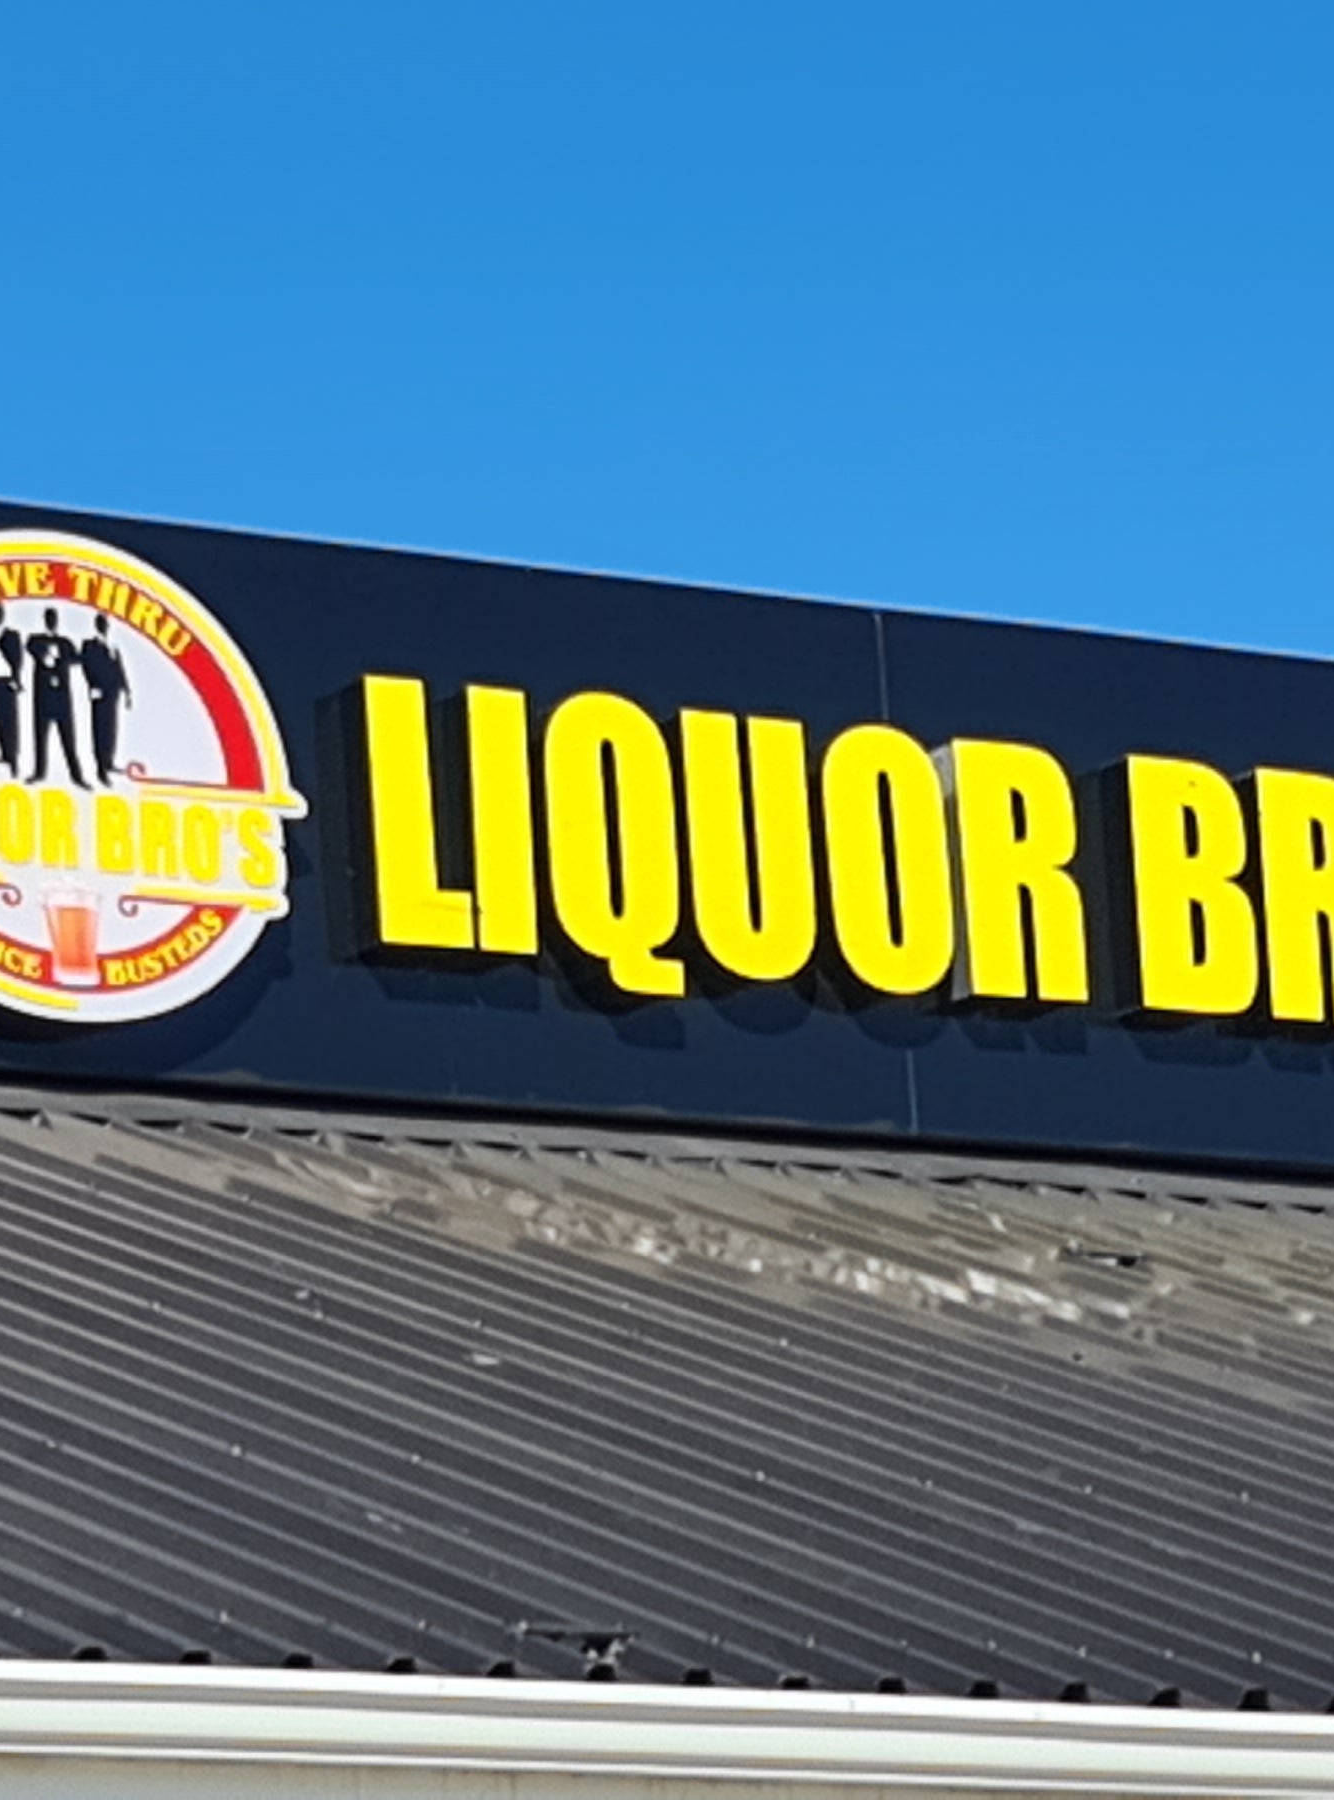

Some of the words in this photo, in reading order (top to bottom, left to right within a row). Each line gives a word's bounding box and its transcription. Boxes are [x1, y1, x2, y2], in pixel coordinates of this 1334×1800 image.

[67, 567, 193, 657] THRU
[96, 795, 277, 888] BRO'S
[364, 674, 1089, 1002] LIQUOR
